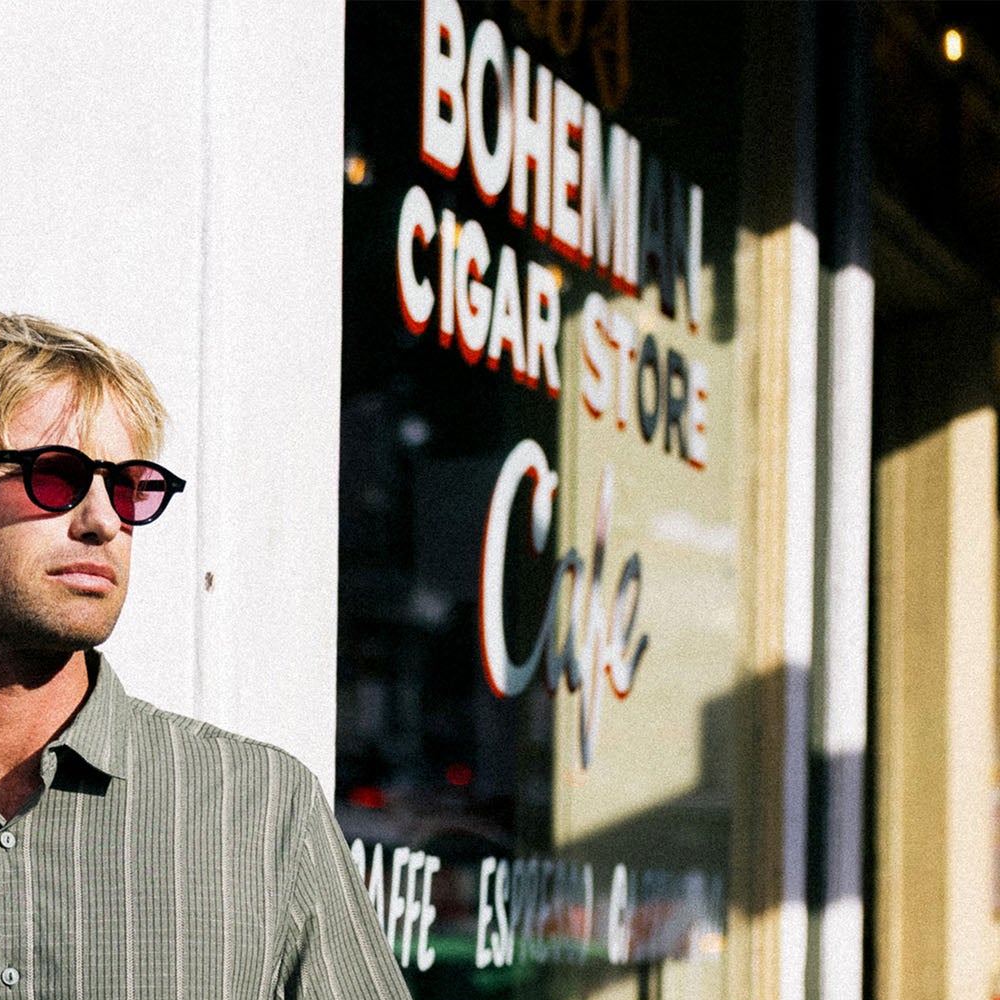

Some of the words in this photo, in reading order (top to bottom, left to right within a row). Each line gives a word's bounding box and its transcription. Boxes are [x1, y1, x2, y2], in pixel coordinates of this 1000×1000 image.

[397, 184, 561, 398] CIGAR
[581, 291, 709, 471] STORE
[420, 0, 704, 335] BOHEMIAN
[479, 438, 648, 770] Cafe
